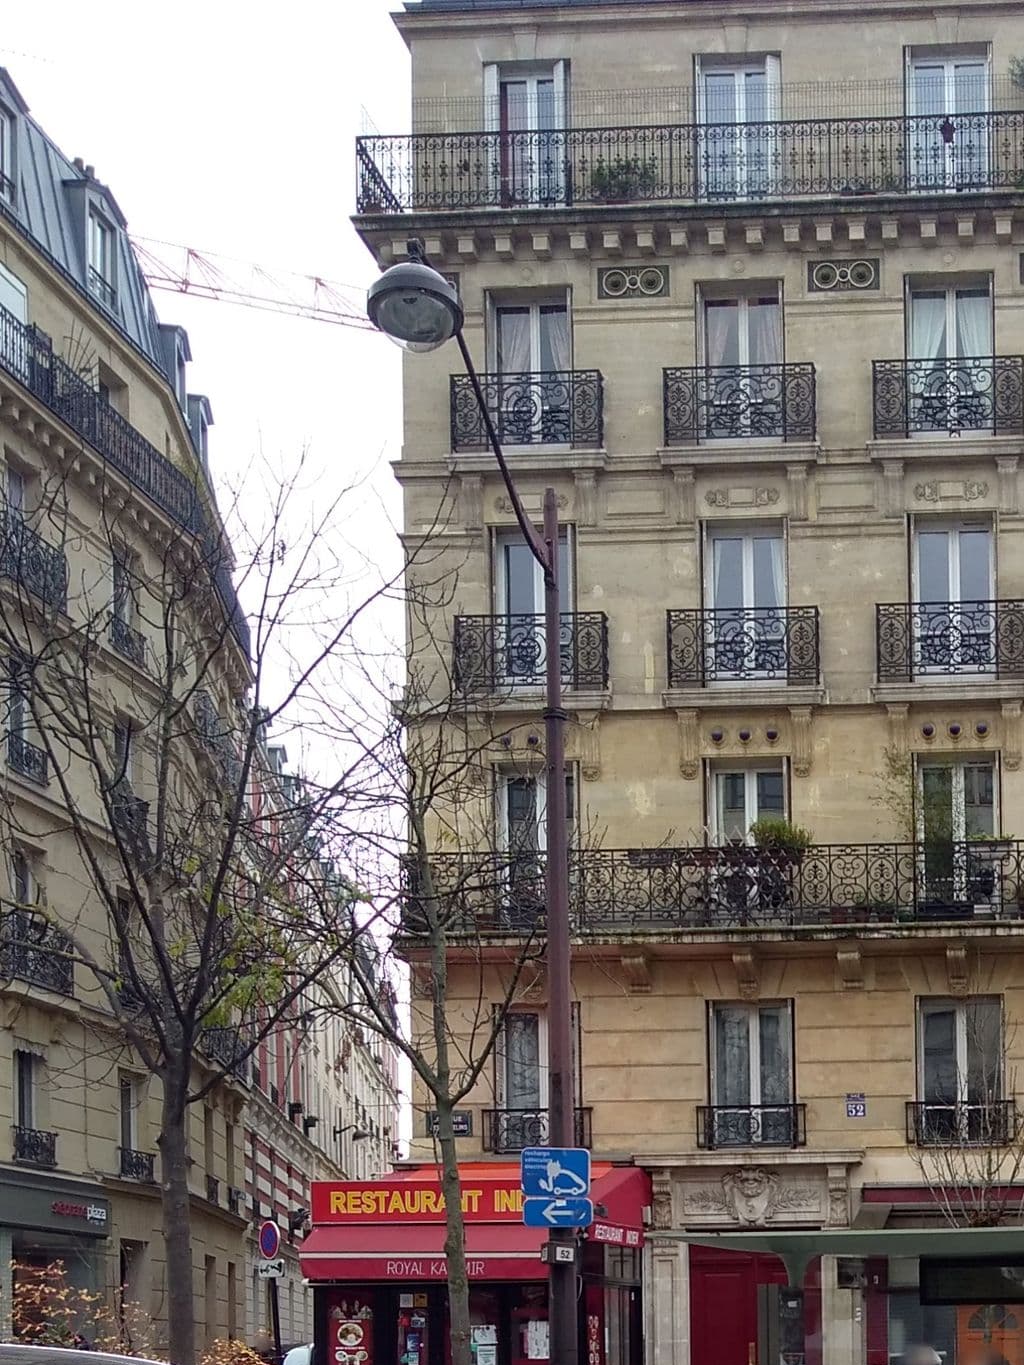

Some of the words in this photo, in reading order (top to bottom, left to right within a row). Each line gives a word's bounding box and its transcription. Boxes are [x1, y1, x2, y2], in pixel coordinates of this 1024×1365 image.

[847, 1104, 864, 1116] 52
[560, 1249, 570, 1260] 52
[386, 1261, 426, 1276] ROYAL
